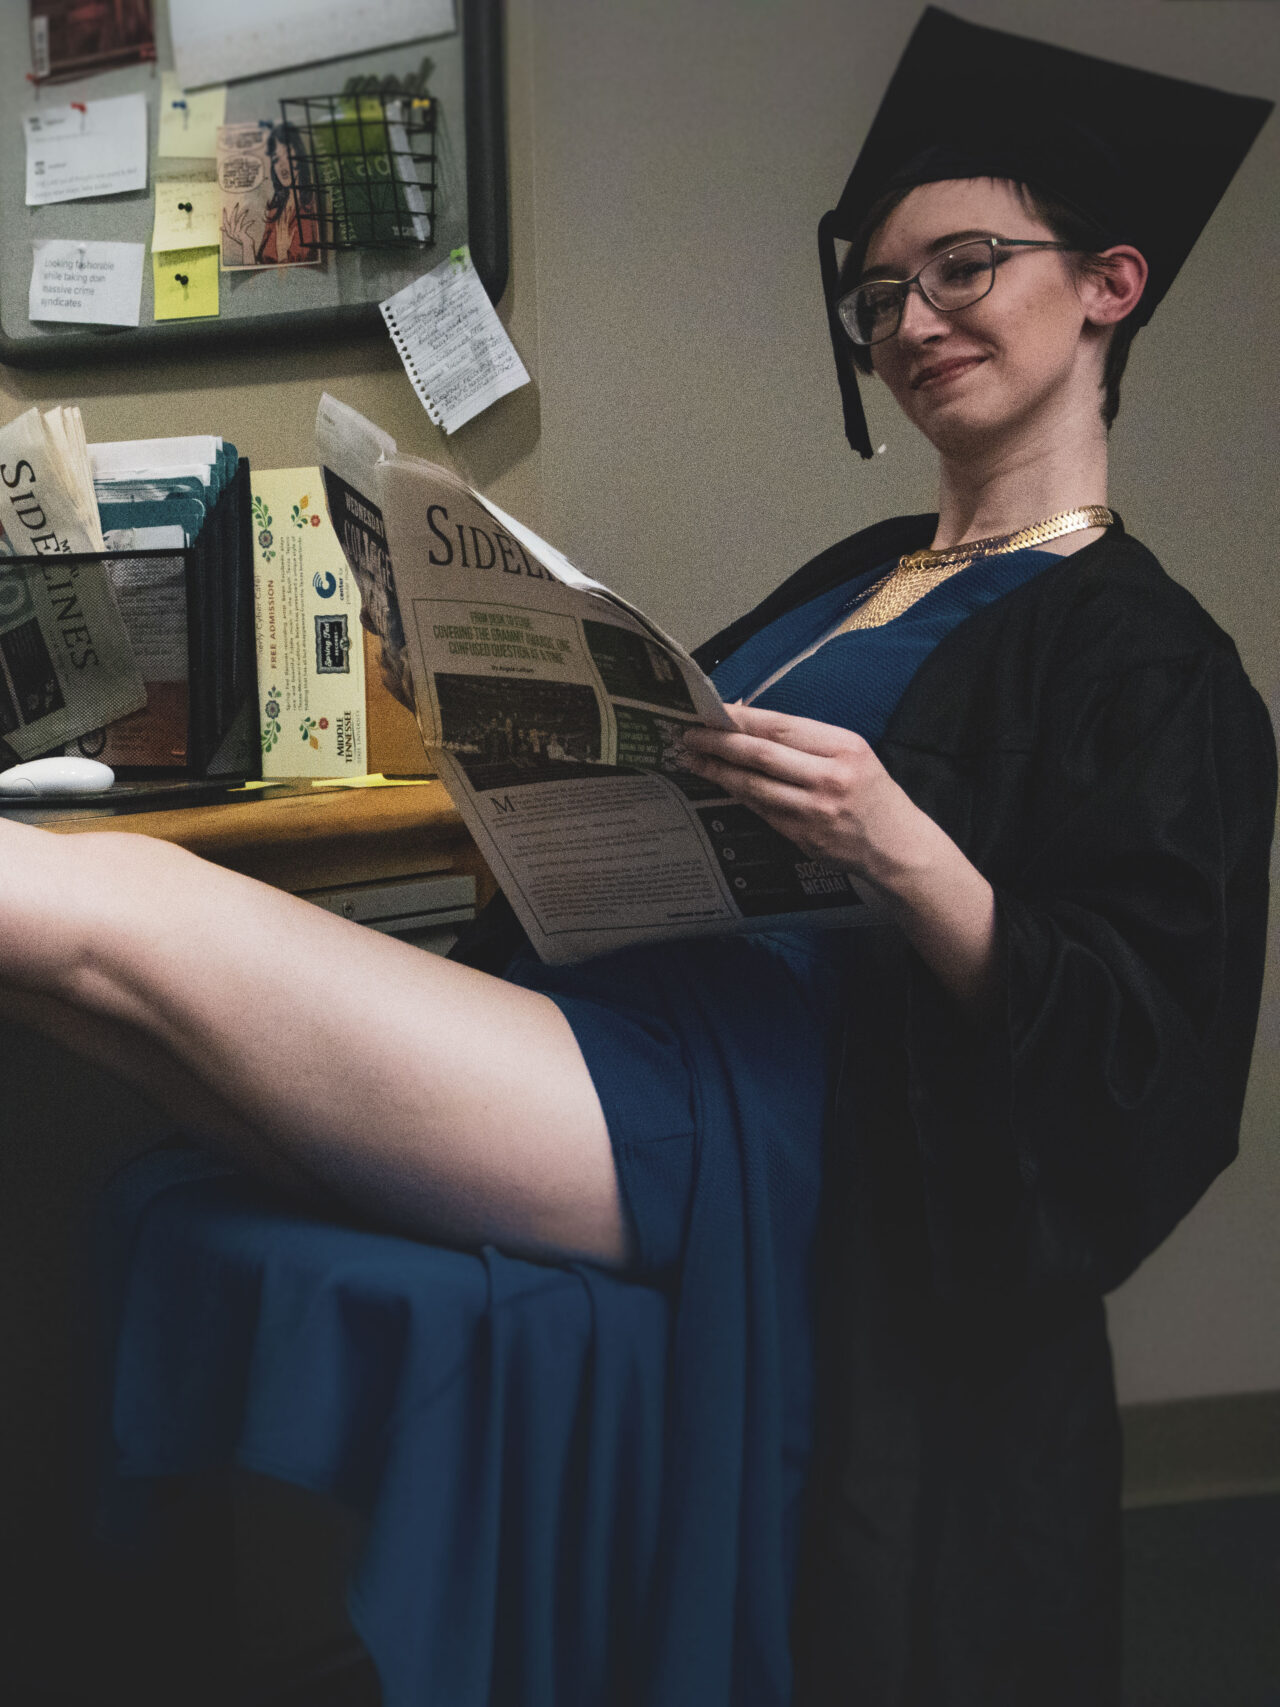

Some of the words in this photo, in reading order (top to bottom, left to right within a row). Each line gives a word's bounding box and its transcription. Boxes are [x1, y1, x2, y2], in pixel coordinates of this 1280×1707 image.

[267, 580, 276, 641] ADMISSION
[433, 625, 472, 639] COVERING
[269, 643, 277, 670] FREE
[323, 640, 333, 667] Spring
[336, 717, 344, 757] MIDDLE
[344, 711, 353, 764] TENNESSEE
[795, 860, 845, 880] SOCIA
